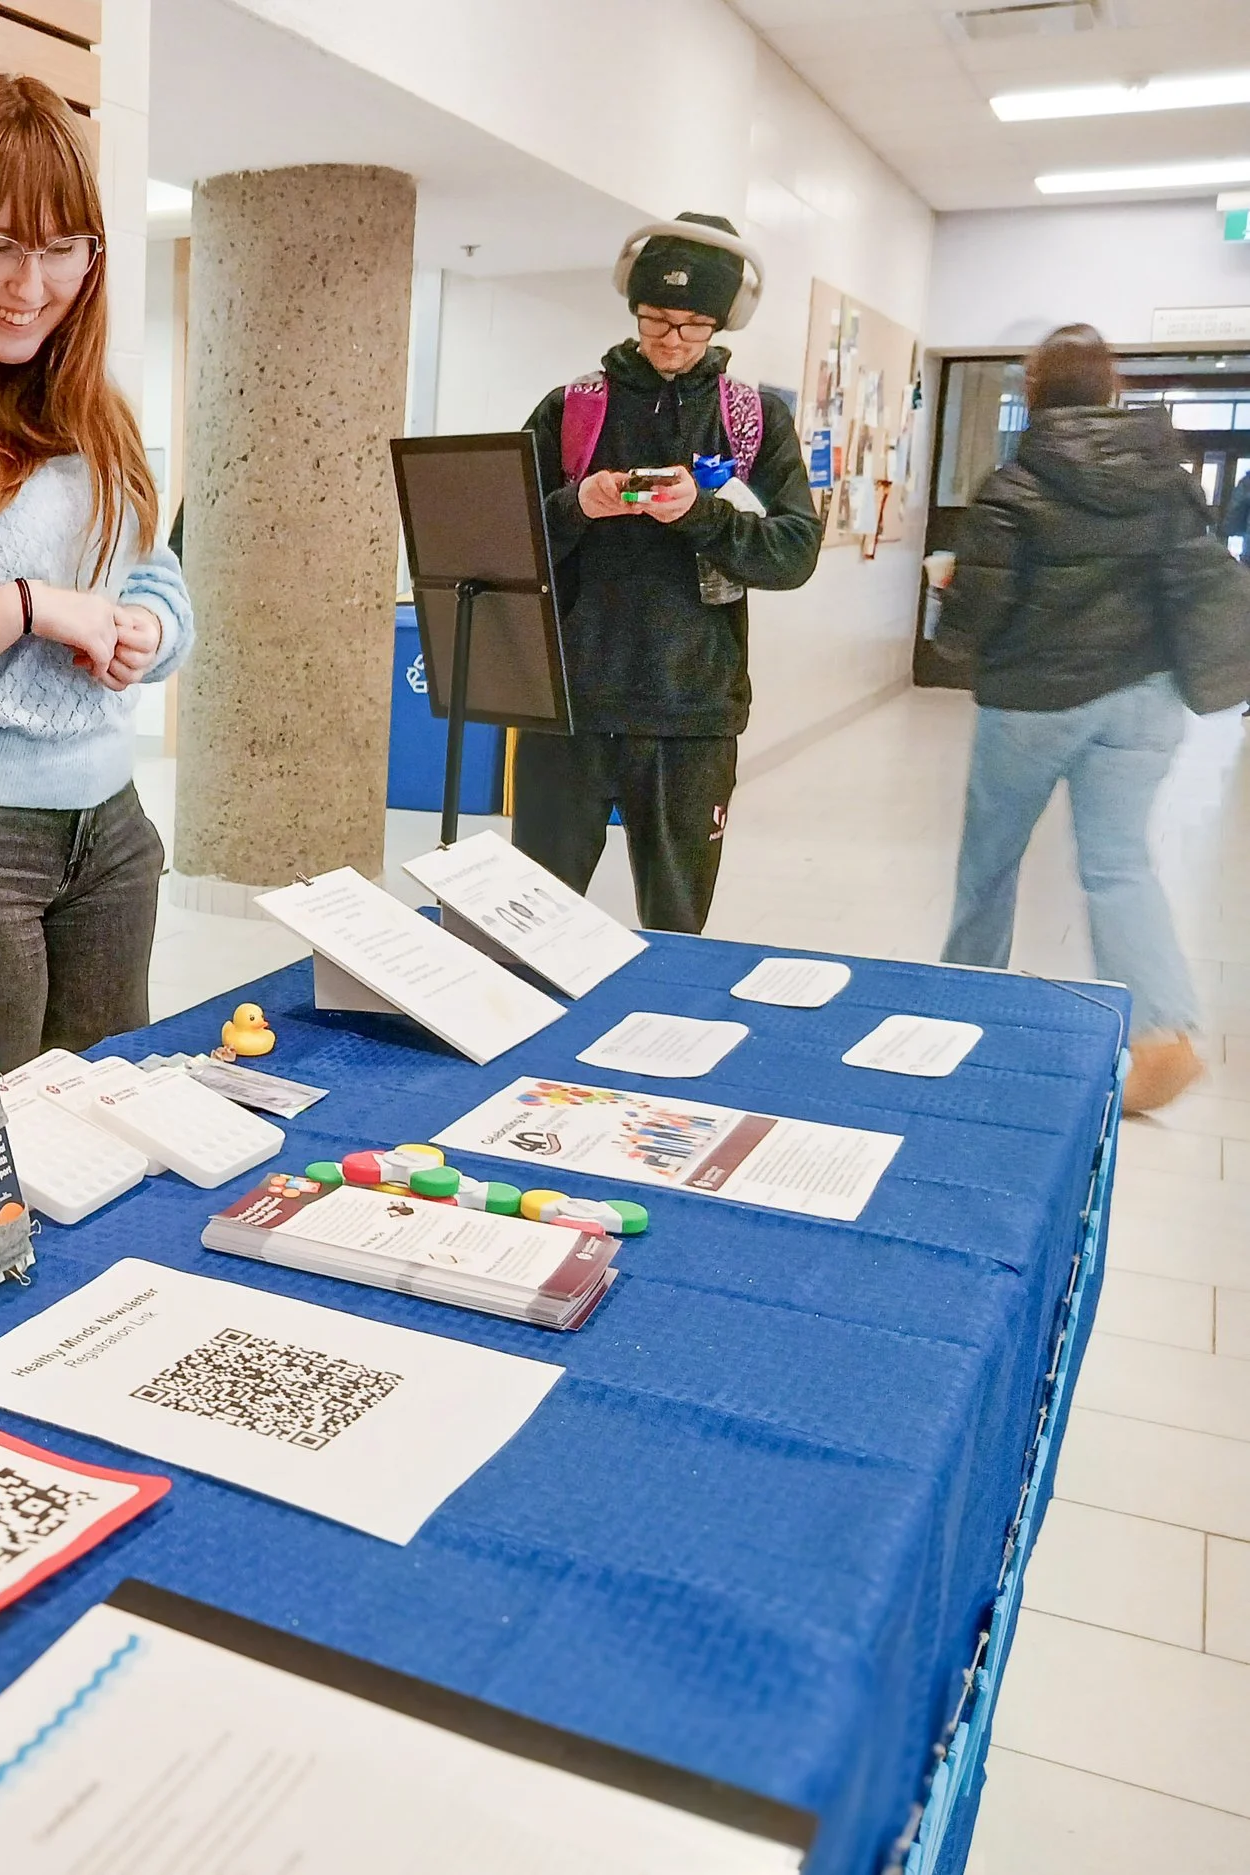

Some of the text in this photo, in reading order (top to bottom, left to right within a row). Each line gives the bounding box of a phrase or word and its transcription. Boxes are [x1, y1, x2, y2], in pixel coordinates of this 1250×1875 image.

[11, 1287, 159, 1378] Healthy Minds Newsletter
[63, 1311, 160, 1368] Registration Link
